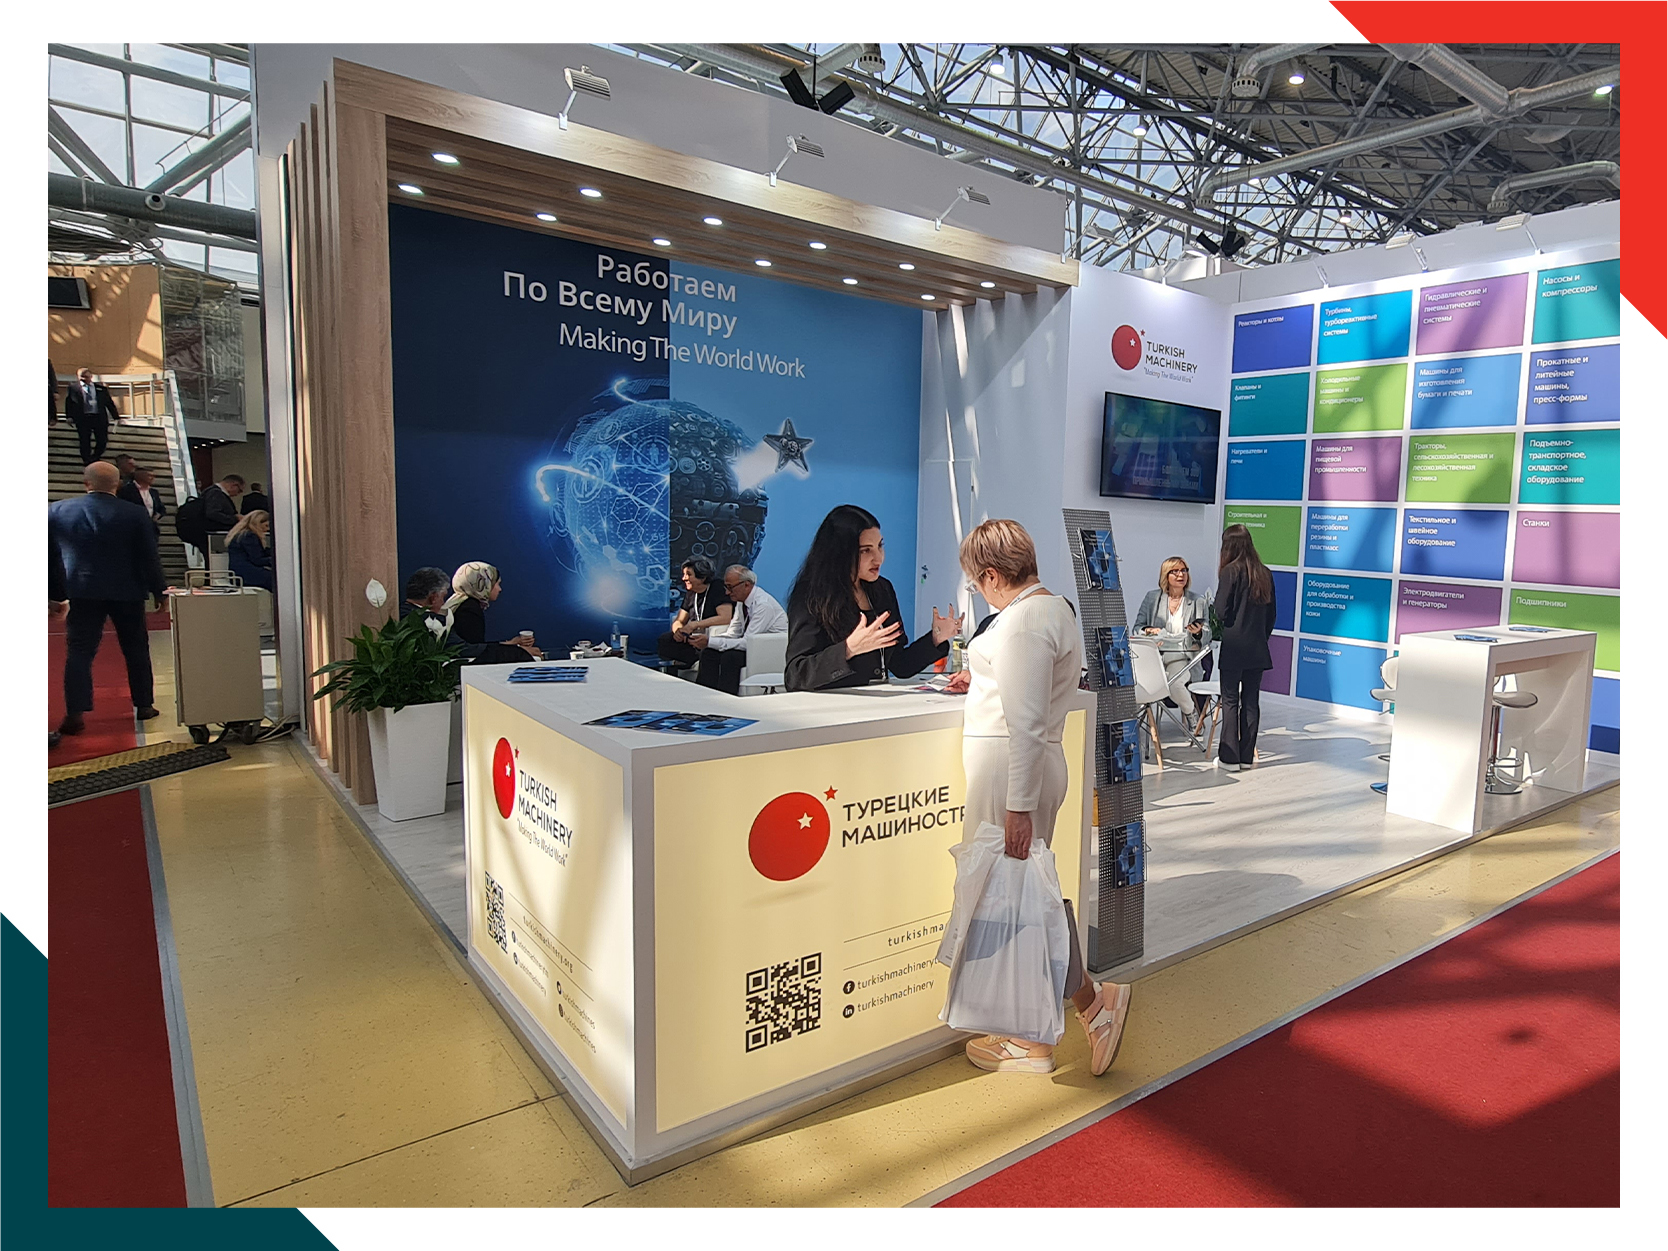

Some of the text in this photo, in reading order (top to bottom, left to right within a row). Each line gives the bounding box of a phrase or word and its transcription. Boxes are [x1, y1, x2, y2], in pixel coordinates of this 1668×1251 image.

[597, 254, 736, 302] Работаем
[1543, 275, 1572, 285] Насосы
[1424, 289, 1481, 302] Гидравлические
[1542, 284, 1597, 298] компрессоры
[503, 271, 737, 338] По Всему Миру
[1424, 300, 1481, 313] пневматические
[1423, 315, 1452, 324] системы
[1323, 328, 1348, 336] системы
[559, 323, 806, 378] Making The World Work
[1146, 341, 1185, 358] TURKISH
[1145, 355, 1198, 374] MACHINERY
[1537, 357, 1580, 368] Прокатные
[1420, 366, 1463, 376] Машины для
[1535, 369, 1575, 379] литейные
[1418, 378, 1465, 386] изготовления
[1534, 382, 1569, 391] машины,
[1418, 390, 1442, 400] бумаги
[1533, 393, 1588, 404] пресс-формы
[1530, 440, 1574, 448] Подъемно-
[1529, 451, 1586, 460] транспортное,
[1314, 466, 1367, 474] промышленности
[1528, 464, 1568, 472] складское
[1527, 476, 1584, 485] оборудование
[1409, 516, 1450, 524] Текстильное
[1522, 519, 1550, 527] Станки
[1407, 538, 1456, 547] оборудование
[1308, 580, 1349, 590] Оборудование
[1318, 592, 1349, 600] обработки
[1403, 587, 1464, 599] Электродвигатели
[1306, 601, 1345, 610] производства
[1408, 600, 1447, 609] генераторы
[1516, 597, 1567, 608] Подшипники
[1303, 645, 1341, 656] Упаковочные
[520, 770, 557, 812] TURKISH
[843, 785, 950, 821] ТУРЕЦКИЕ
[519, 794, 572, 848] MACHINERY
[888, 923, 944, 946] turkishma
[858, 979, 934, 1012] turkishmachinery
